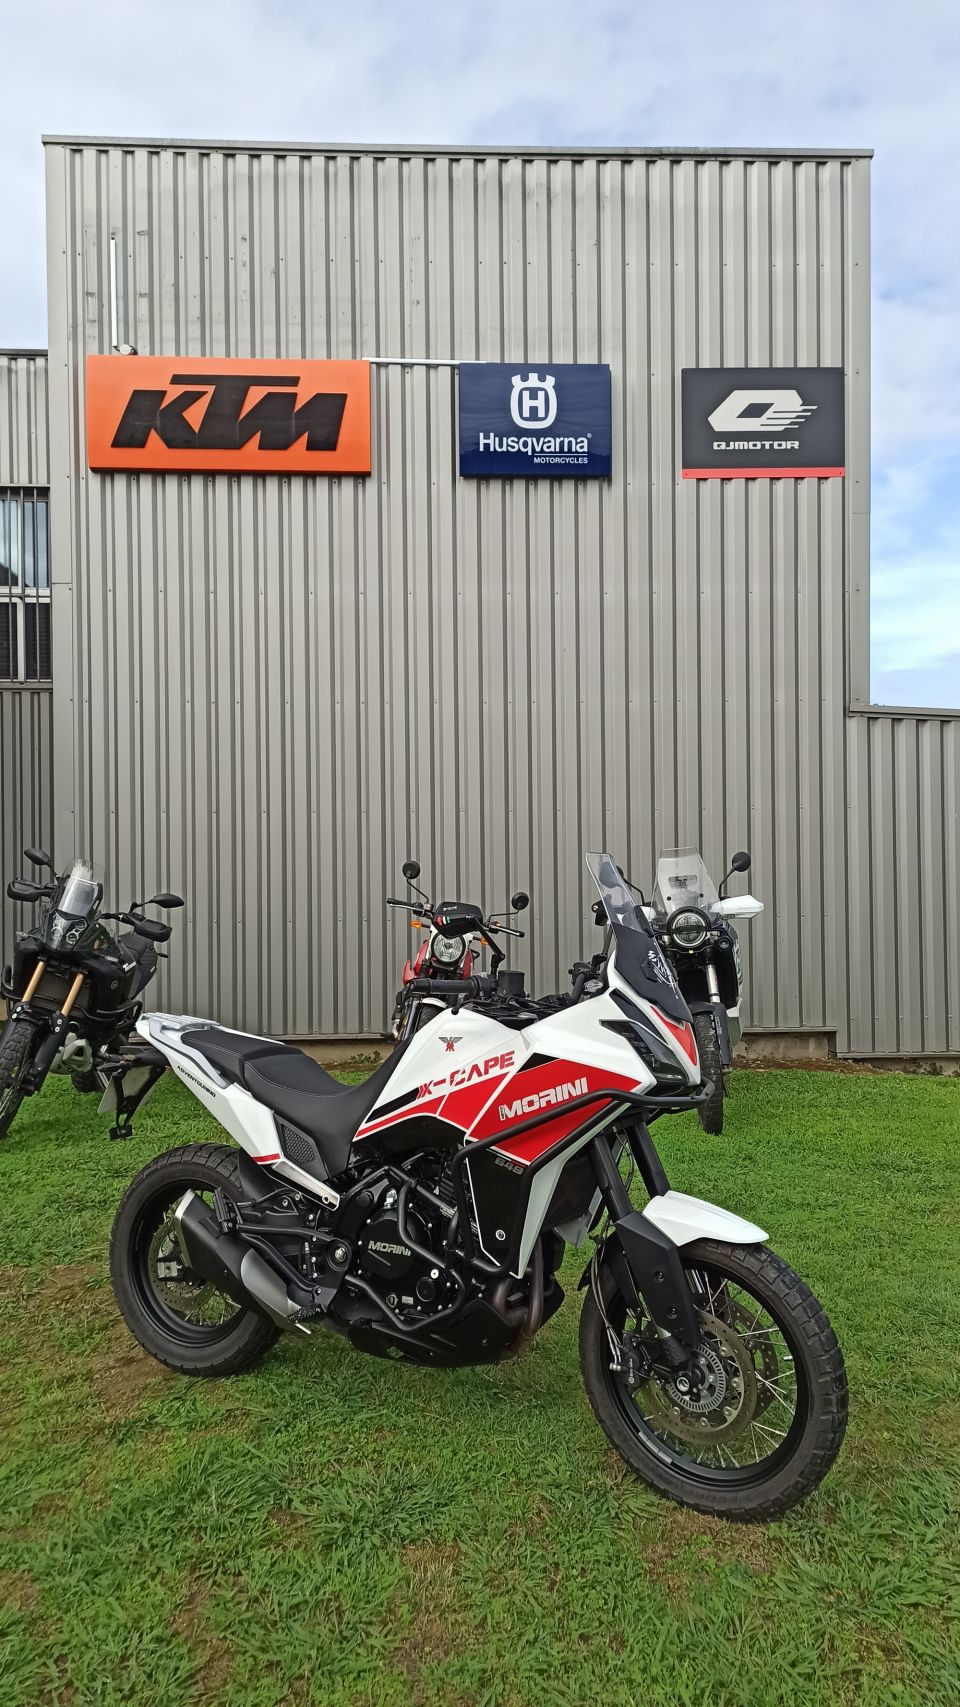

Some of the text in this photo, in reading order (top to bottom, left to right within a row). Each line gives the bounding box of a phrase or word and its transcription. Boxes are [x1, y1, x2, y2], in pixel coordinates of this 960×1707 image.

[110, 373, 348, 452] KTM
[713, 441, 800, 450] QJMOTOR
[533, 456, 588, 464] MOTORCYCLES
[417, 1050, 515, 1099] X-CAPE
[498, 1076, 589, 1121] MORINI
[494, 1157, 525, 1175] 649
[368, 1240, 412, 1257] MORINI
